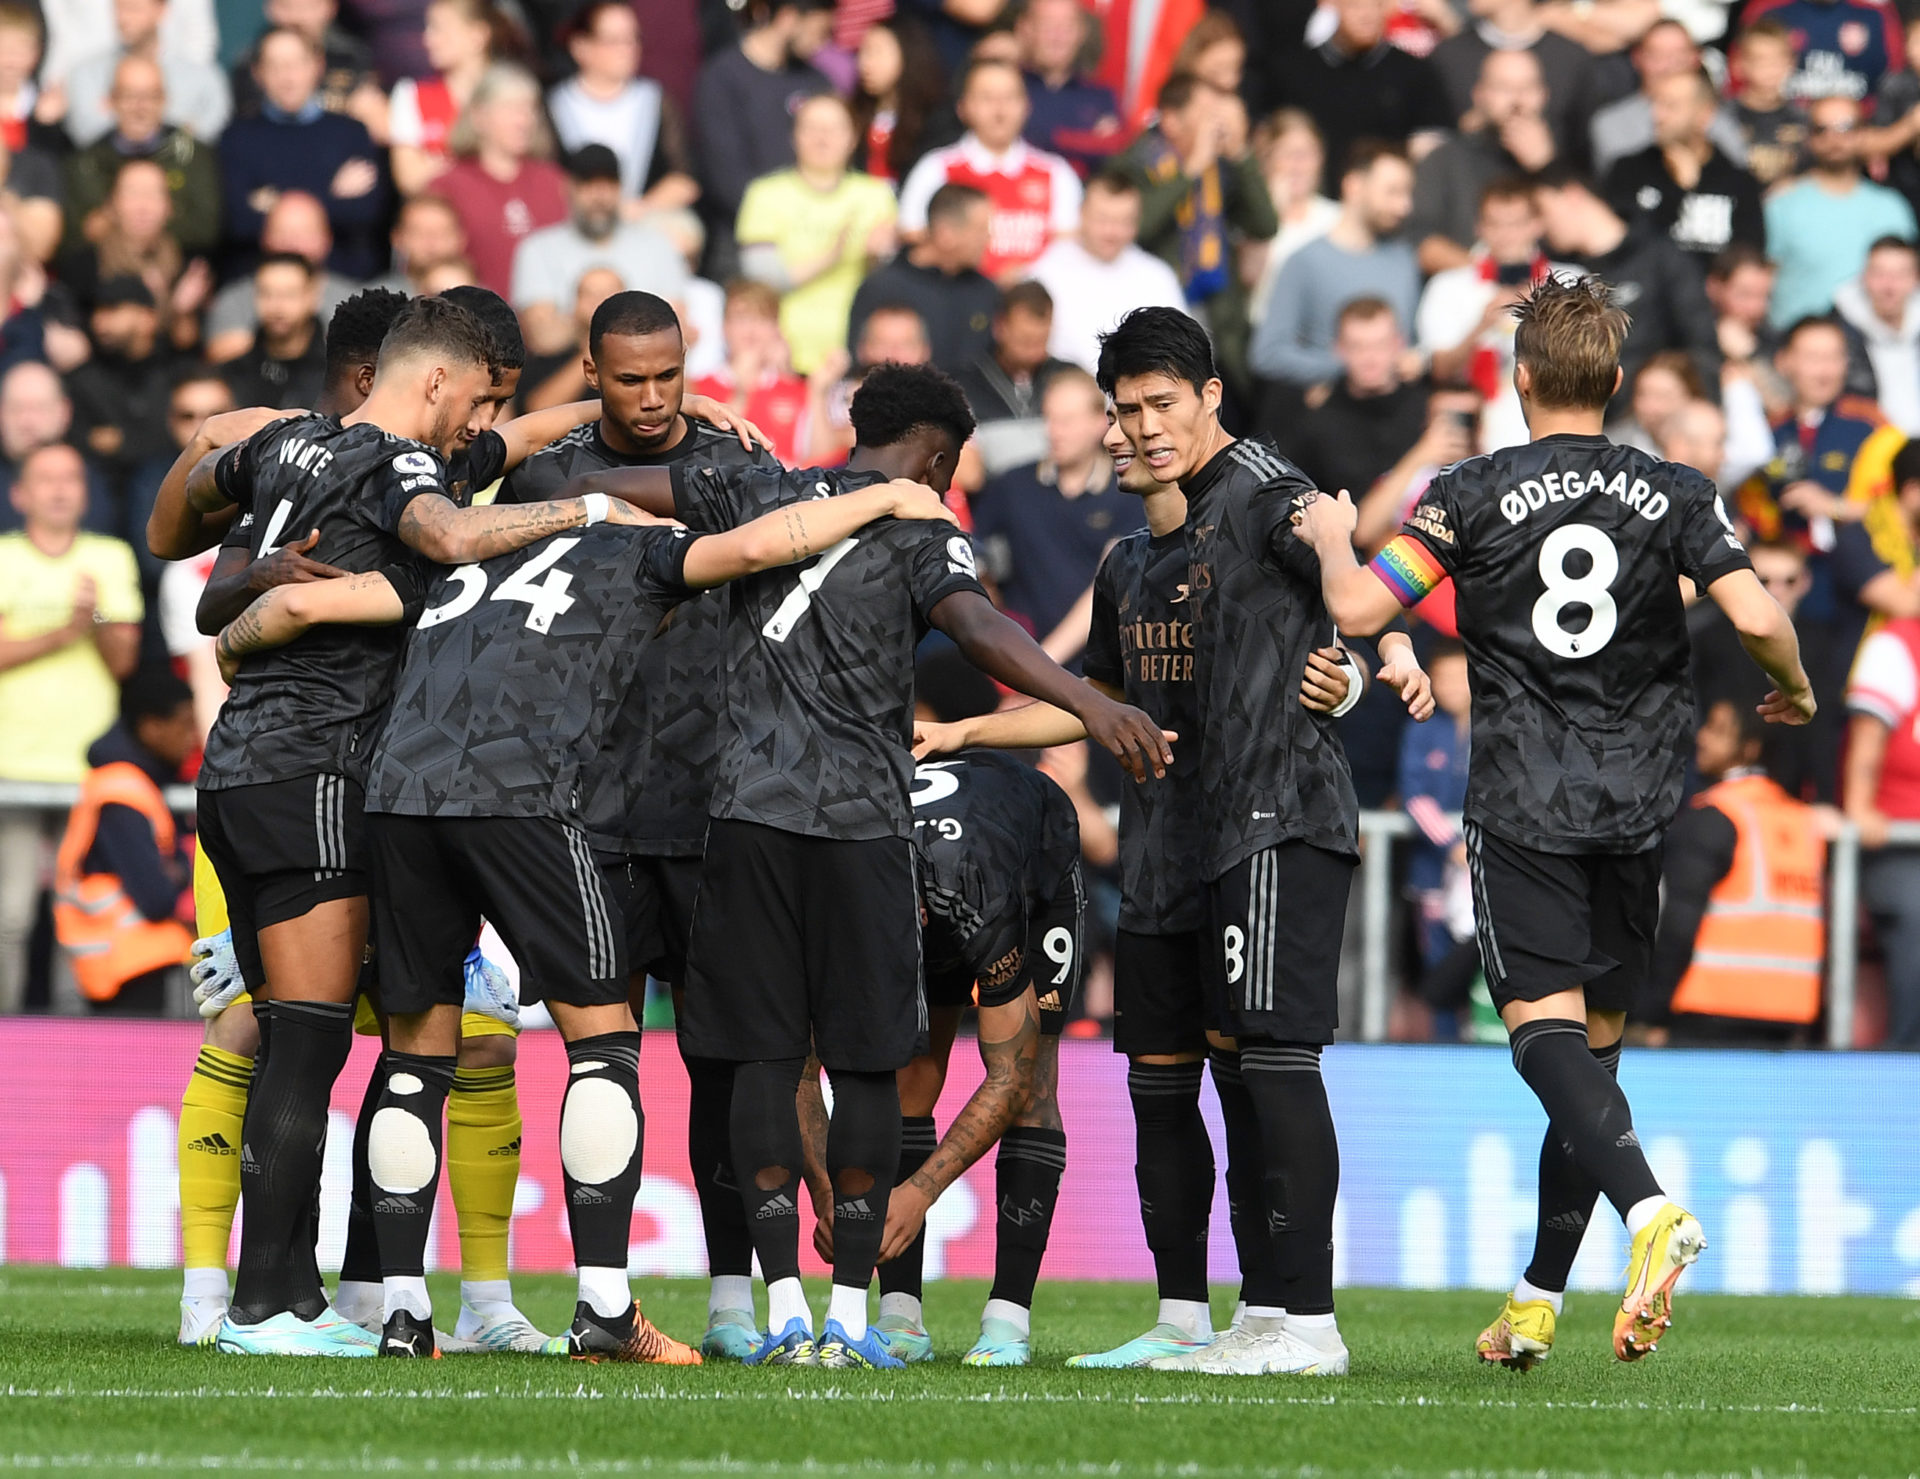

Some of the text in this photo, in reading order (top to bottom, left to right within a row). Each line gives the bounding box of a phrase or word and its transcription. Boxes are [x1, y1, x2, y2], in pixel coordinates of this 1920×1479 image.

[1500, 470, 1669, 525] ØDEGAARD
[1406, 515, 1455, 545] ANDA
[416, 536, 582, 636] 34
[1383, 547, 1427, 593] aptain
[1531, 523, 1619, 659] 8
[1119, 615, 1195, 651] mirate
[985, 945, 1018, 975] VISIT
[1042, 926, 1074, 985] 9
[1224, 924, 1245, 984] 8
[187, 1143, 237, 1156] adidas
[374, 1205, 424, 1214] adidas
